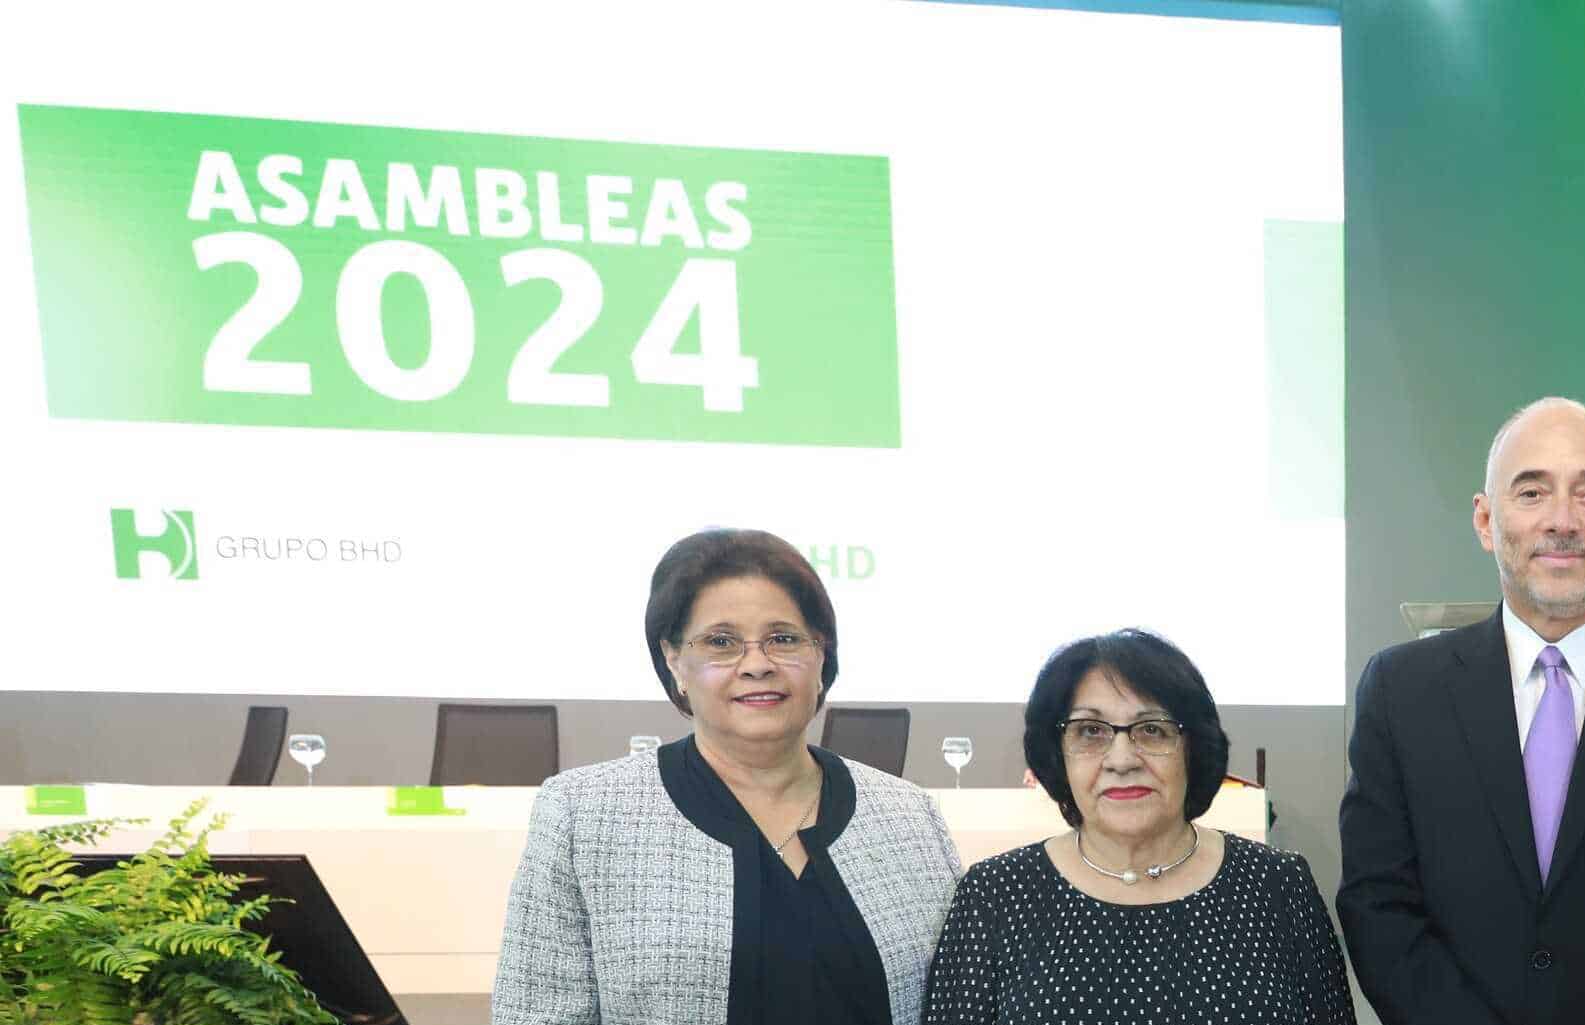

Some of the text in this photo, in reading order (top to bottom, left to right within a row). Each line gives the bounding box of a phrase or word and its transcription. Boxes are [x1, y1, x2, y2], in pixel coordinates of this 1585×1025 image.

[187, 150, 754, 252] ASAMBLEAS
[191, 231, 761, 413] 2024
[215, 535, 402, 563] GRUPO BHD
[798, 544, 877, 580] HD
